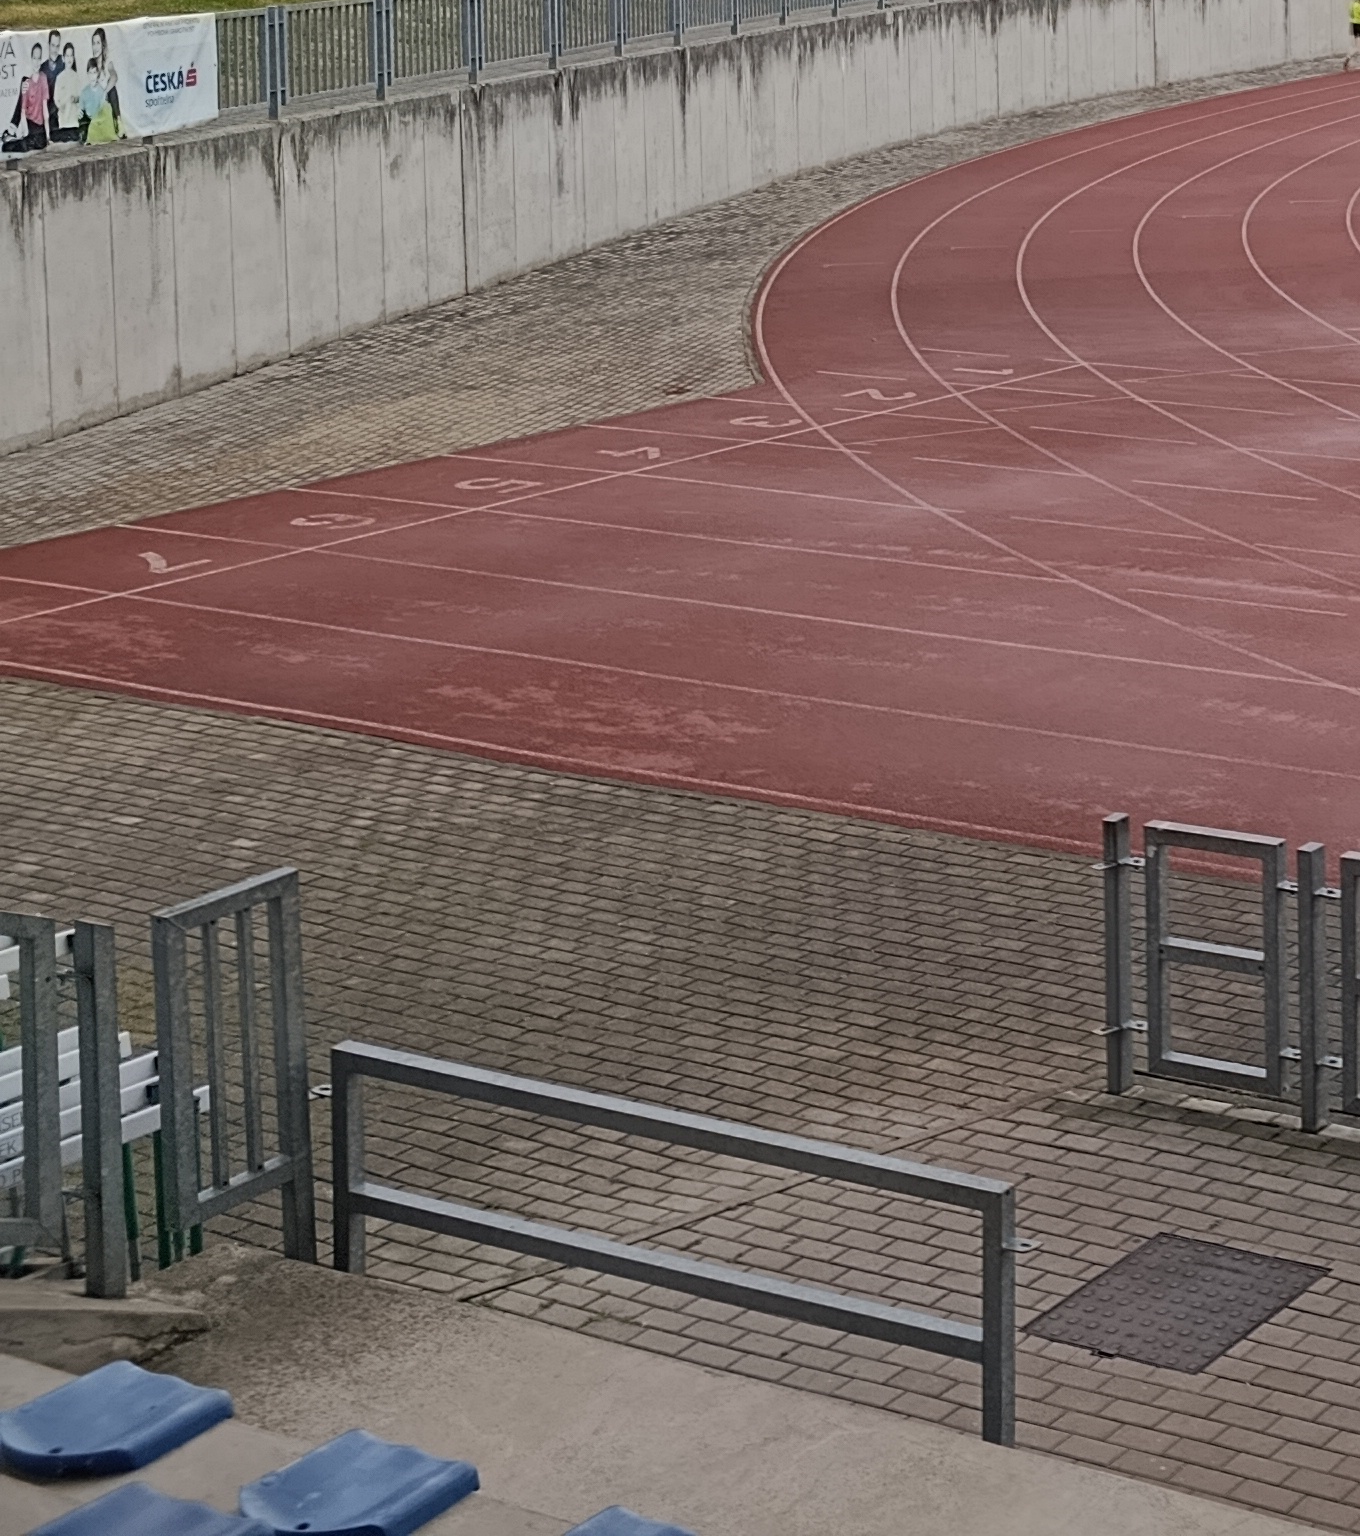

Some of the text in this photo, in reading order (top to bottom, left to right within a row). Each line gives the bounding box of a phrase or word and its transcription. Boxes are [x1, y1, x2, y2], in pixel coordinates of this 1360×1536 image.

[145, 66, 184, 94] ČESKÁ
[841, 388, 917, 401] 2
[729, 415, 803, 429] 3
[454, 477, 545, 494] 5
